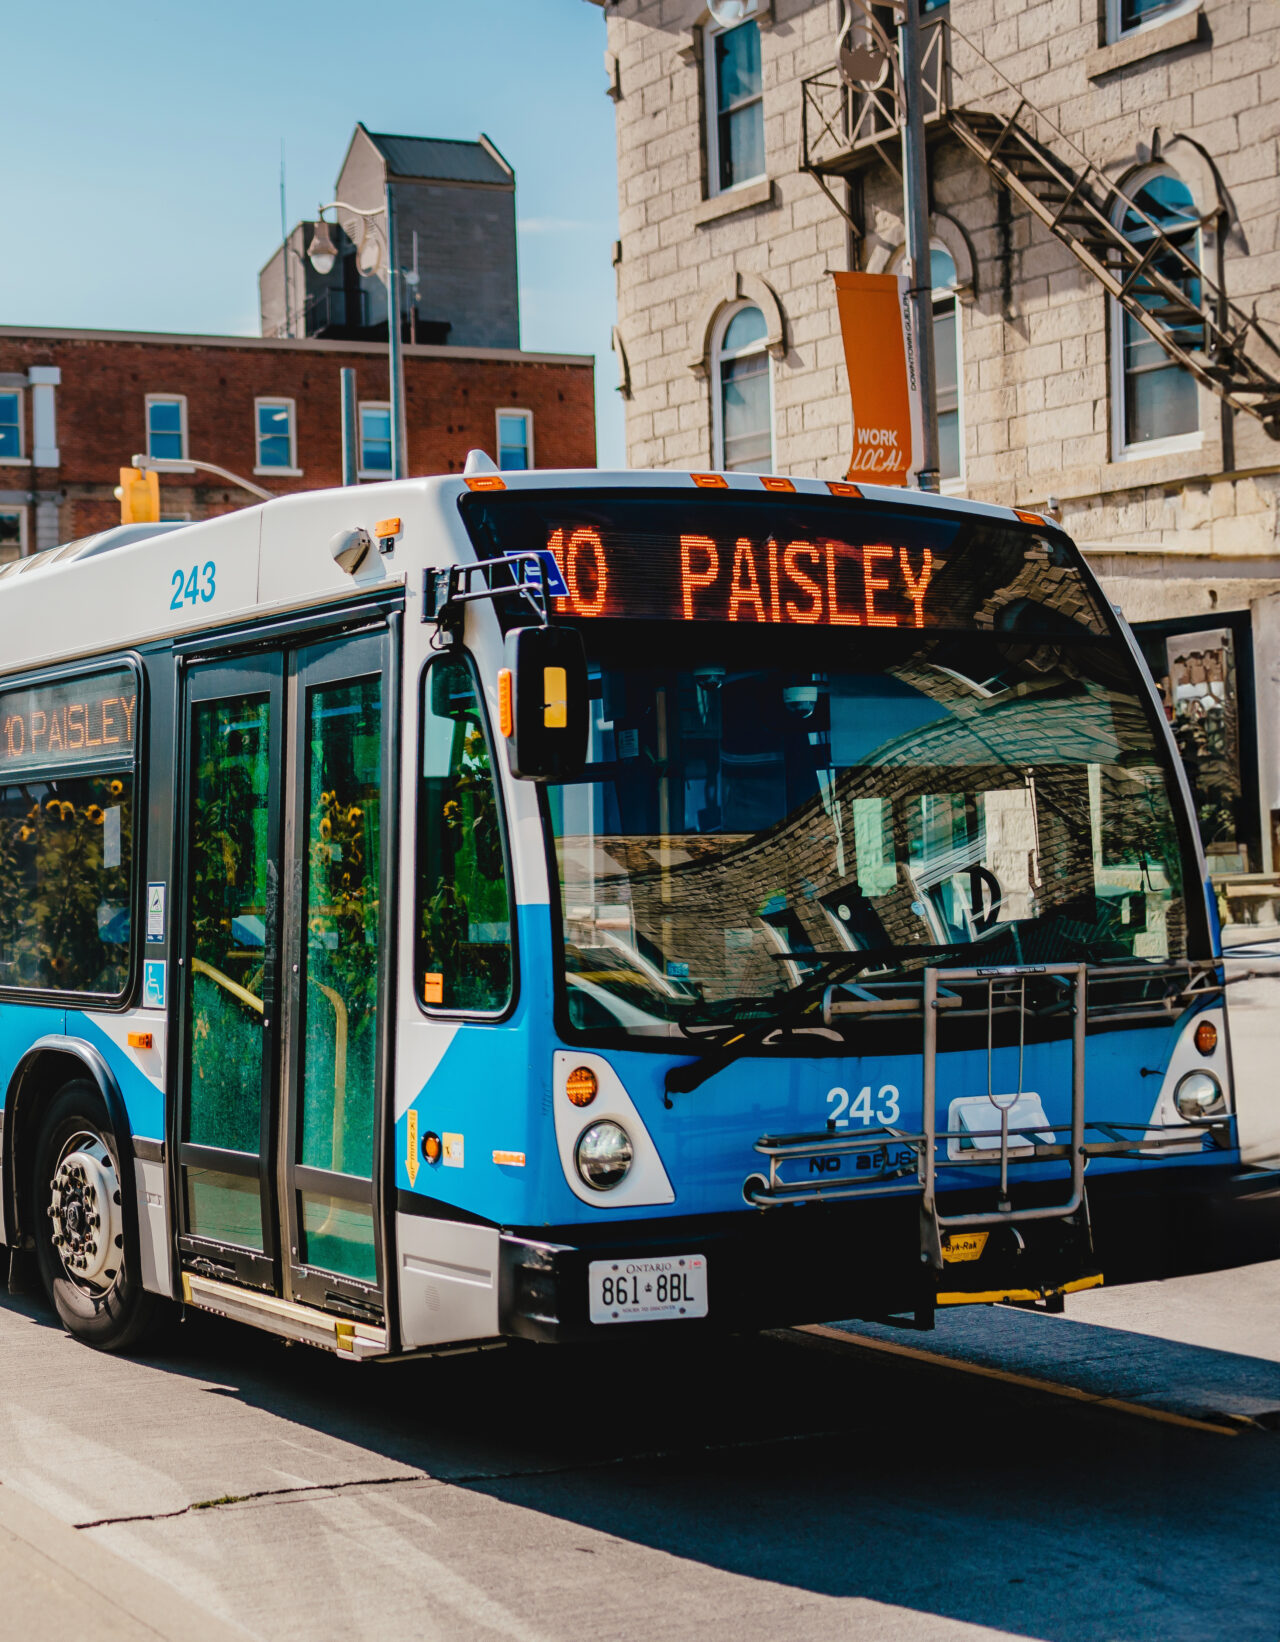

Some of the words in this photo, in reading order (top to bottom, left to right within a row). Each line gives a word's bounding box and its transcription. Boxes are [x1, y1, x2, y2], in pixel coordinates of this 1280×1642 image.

[857, 428, 898, 447] WORK
[852, 448, 905, 472] LOCAL
[170, 560, 216, 611] 243
[547, 528, 608, 616] 10
[680, 535, 932, 628] PAISLEY
[3, 715, 24, 757] 10
[31, 695, 136, 753] PAISLEY
[826, 1084, 900, 1127] 243
[945, 1241, 977, 1252] Byk-Rak
[626, 1262, 672, 1274] ONTARIO
[602, 1275, 640, 1306] 861
[656, 1273, 695, 1303] 8BL
